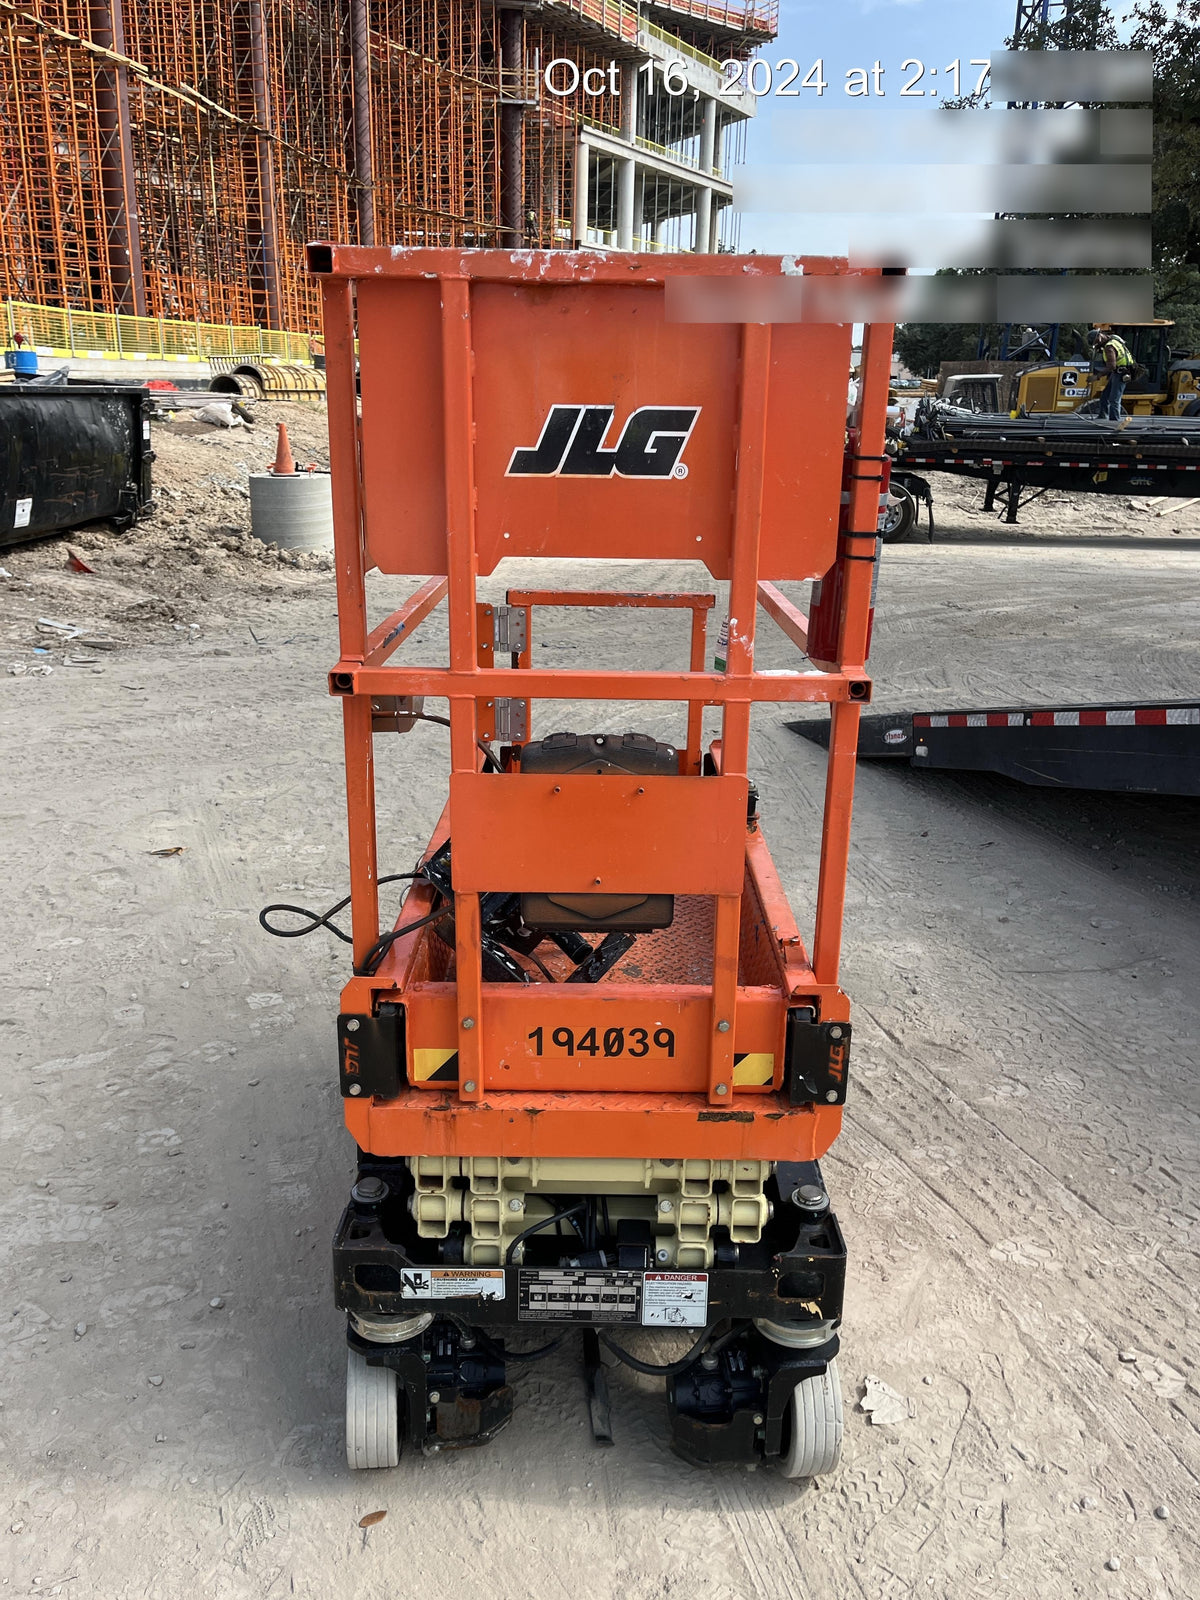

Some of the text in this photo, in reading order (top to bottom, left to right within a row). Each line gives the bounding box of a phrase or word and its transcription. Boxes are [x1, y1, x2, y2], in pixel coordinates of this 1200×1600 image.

[504, 404, 703, 480] JLG
[344, 1037, 359, 1075] JLG
[527, 1026, 676, 1058] 194039
[828, 1044, 845, 1083] JLG
